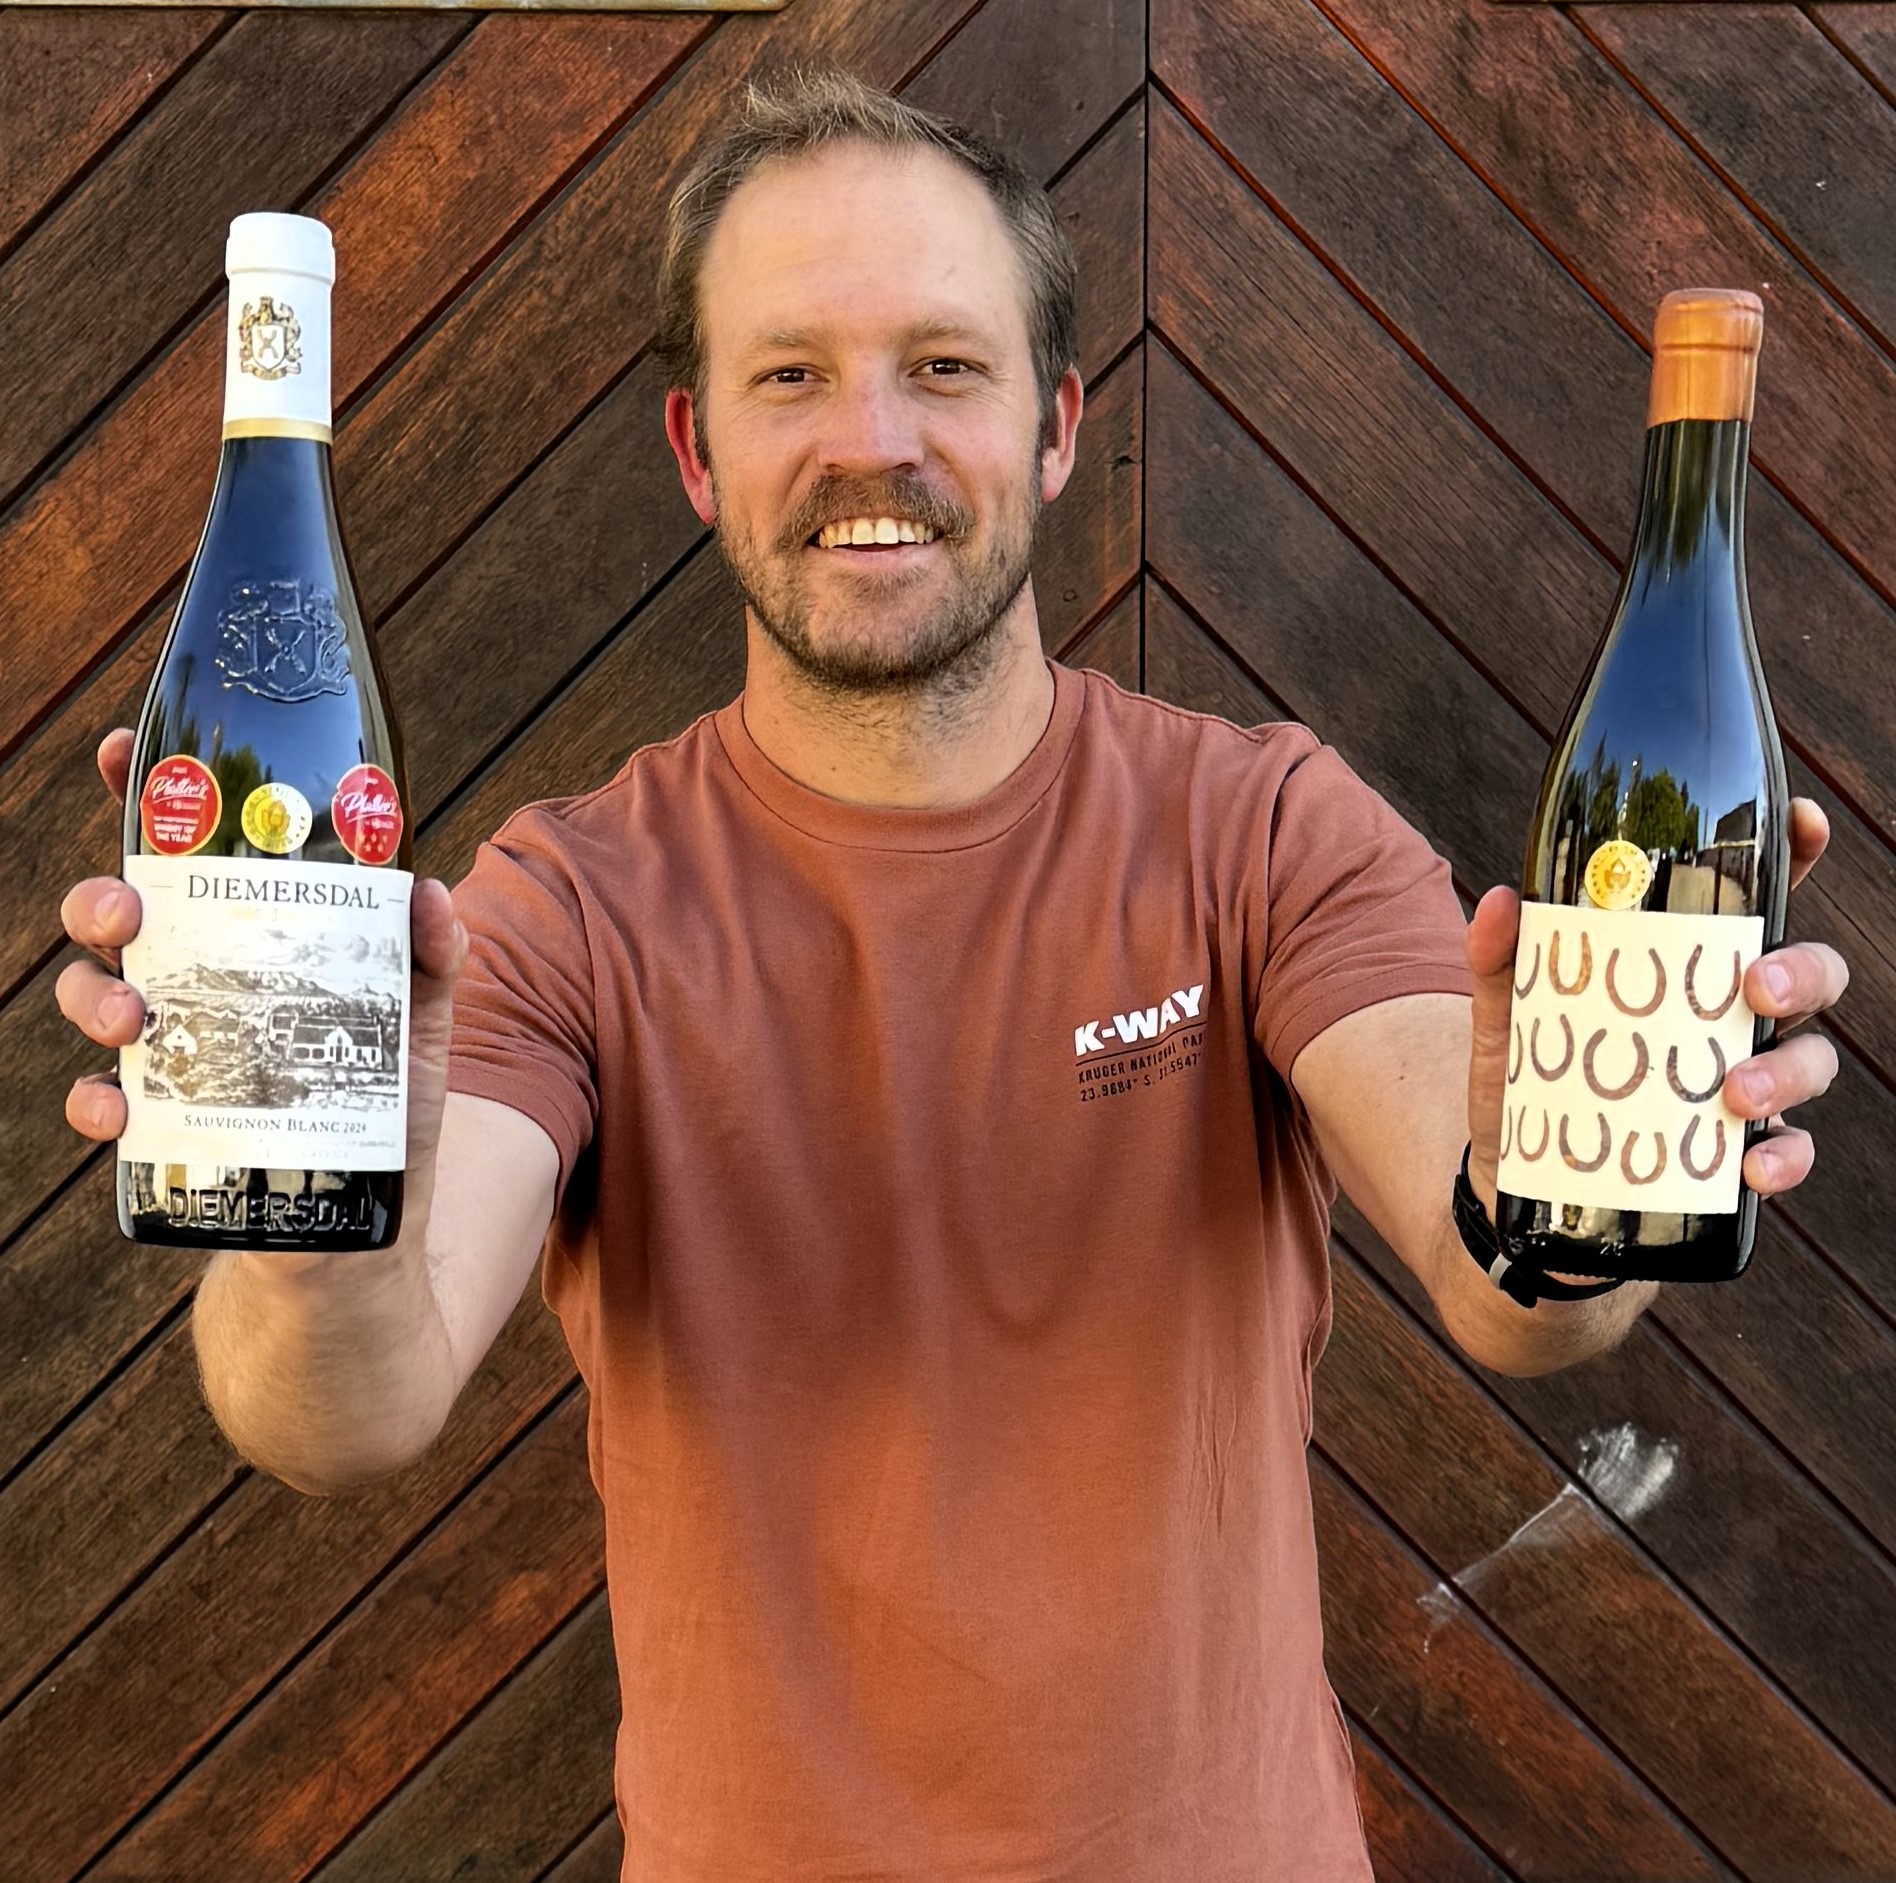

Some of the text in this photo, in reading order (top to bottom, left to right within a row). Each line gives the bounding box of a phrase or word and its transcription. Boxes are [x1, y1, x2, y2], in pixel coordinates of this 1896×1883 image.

[187, 875, 381, 910] DIEMERSDAL
[1074, 984, 1204, 1057] K-WAY
[1078, 1061, 1126, 1085] KRUGER
[183, 1114, 282, 1132] SAUVIGNON
[287, 1118, 341, 1134] BLANC
